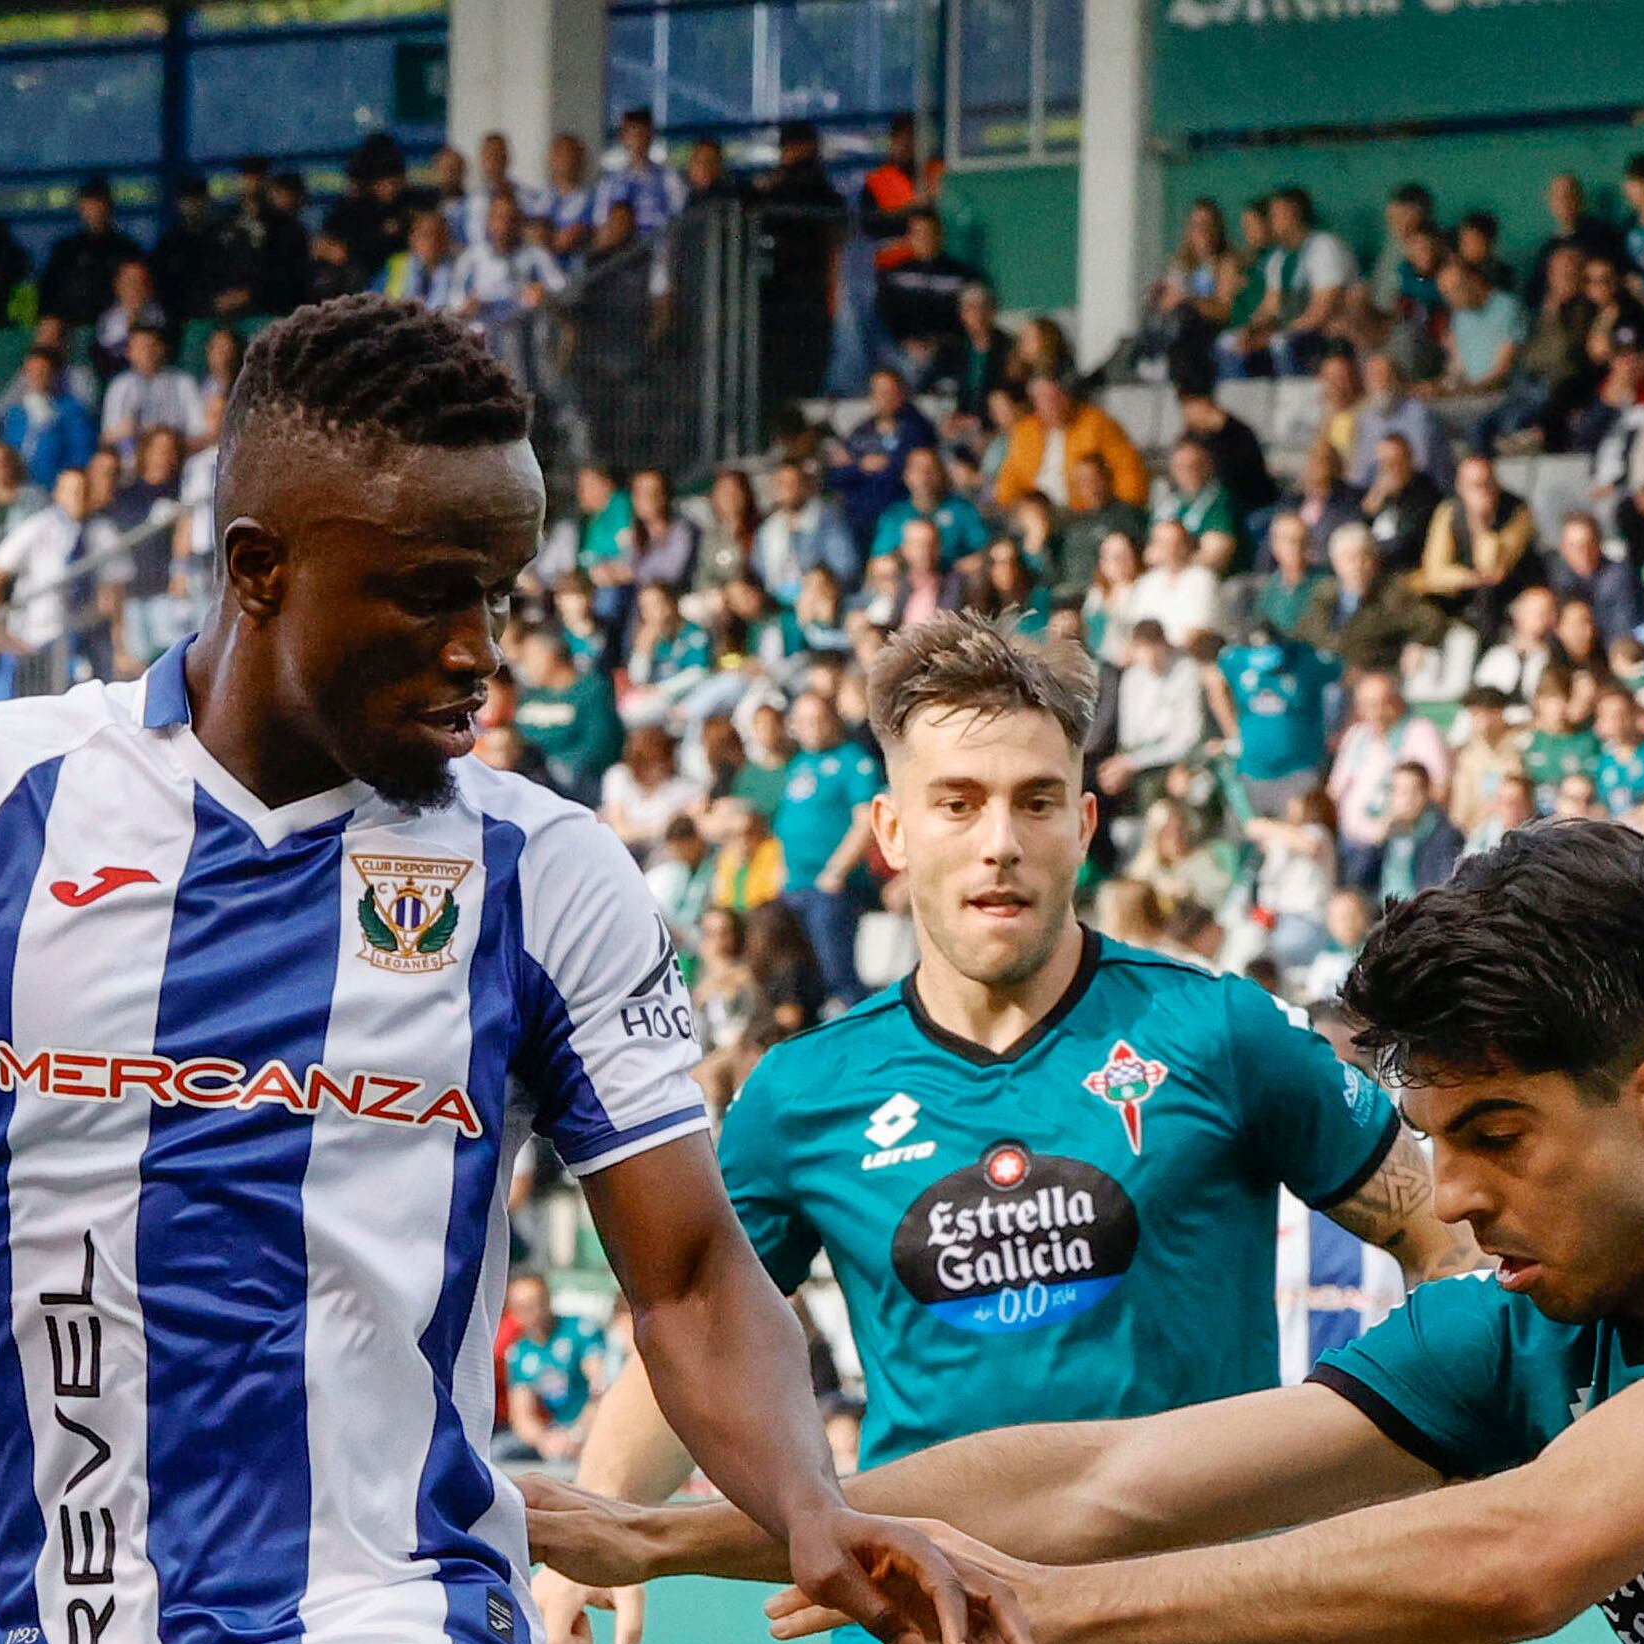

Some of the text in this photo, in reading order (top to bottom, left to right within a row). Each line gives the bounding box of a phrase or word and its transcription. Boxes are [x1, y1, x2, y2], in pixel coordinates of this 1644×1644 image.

[361, 860, 462, 877] CLUB DEPORTIVO
[927, 1185, 1097, 1247] Estrella
[936, 1230, 1095, 1291] Galicia
[997, 1280, 1048, 1324] 0,0
